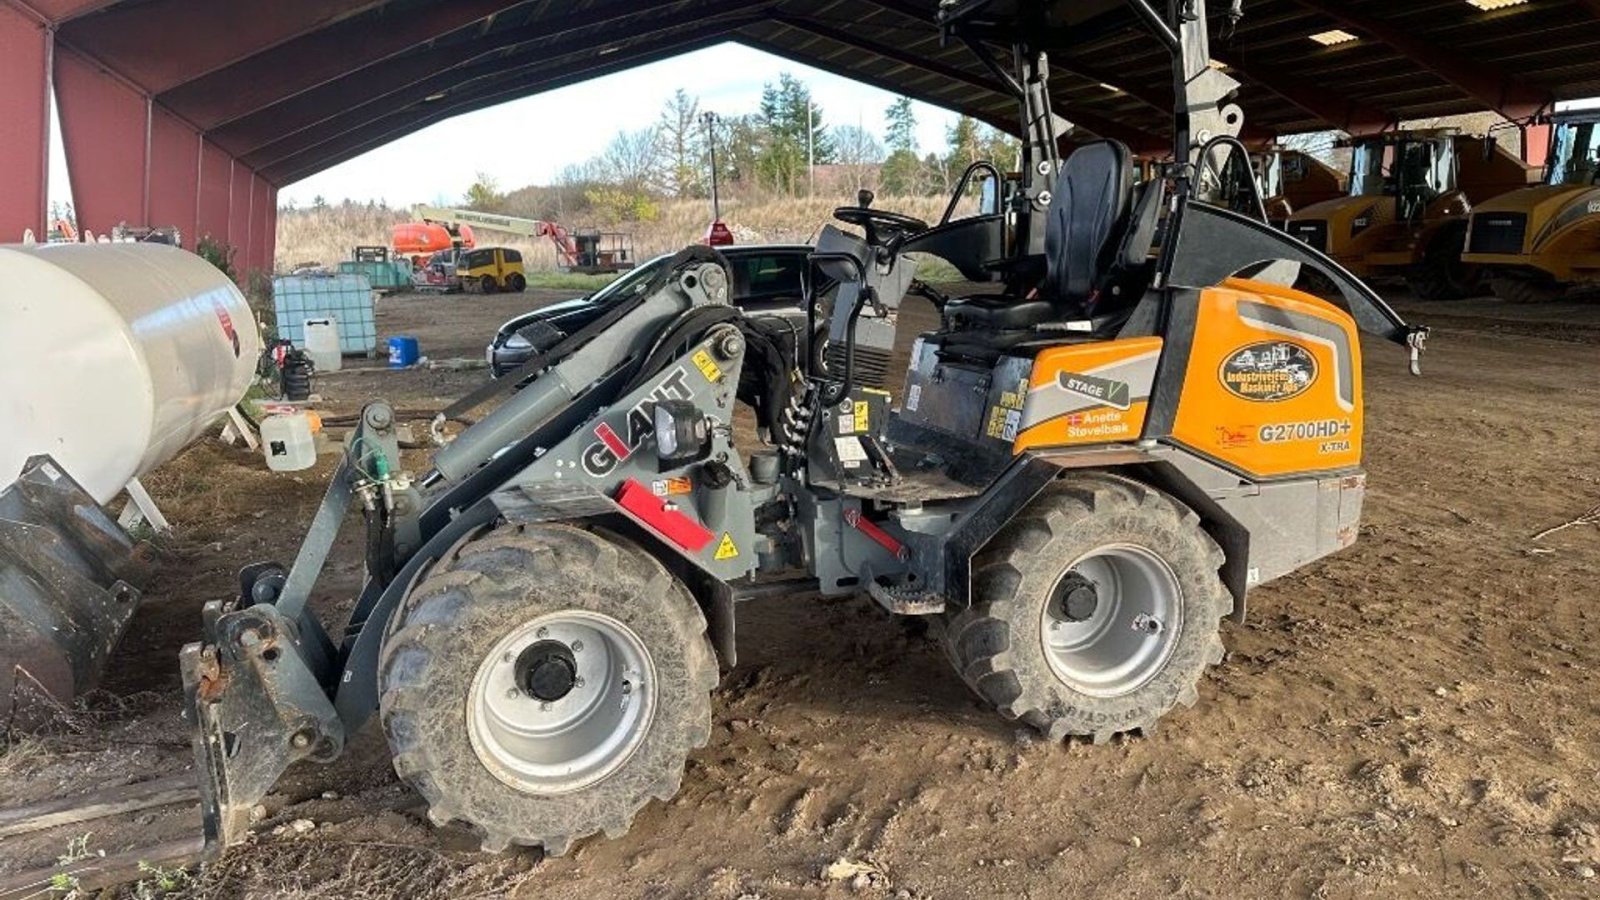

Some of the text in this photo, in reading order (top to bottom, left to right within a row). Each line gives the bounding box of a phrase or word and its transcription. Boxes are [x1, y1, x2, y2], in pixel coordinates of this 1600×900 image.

[1067, 379, 1104, 397] STAGE
[1083, 411, 1121, 425] Anette
[1259, 418, 1351, 443] G2700HD+
[1320, 441, 1350, 453] X-TRA
